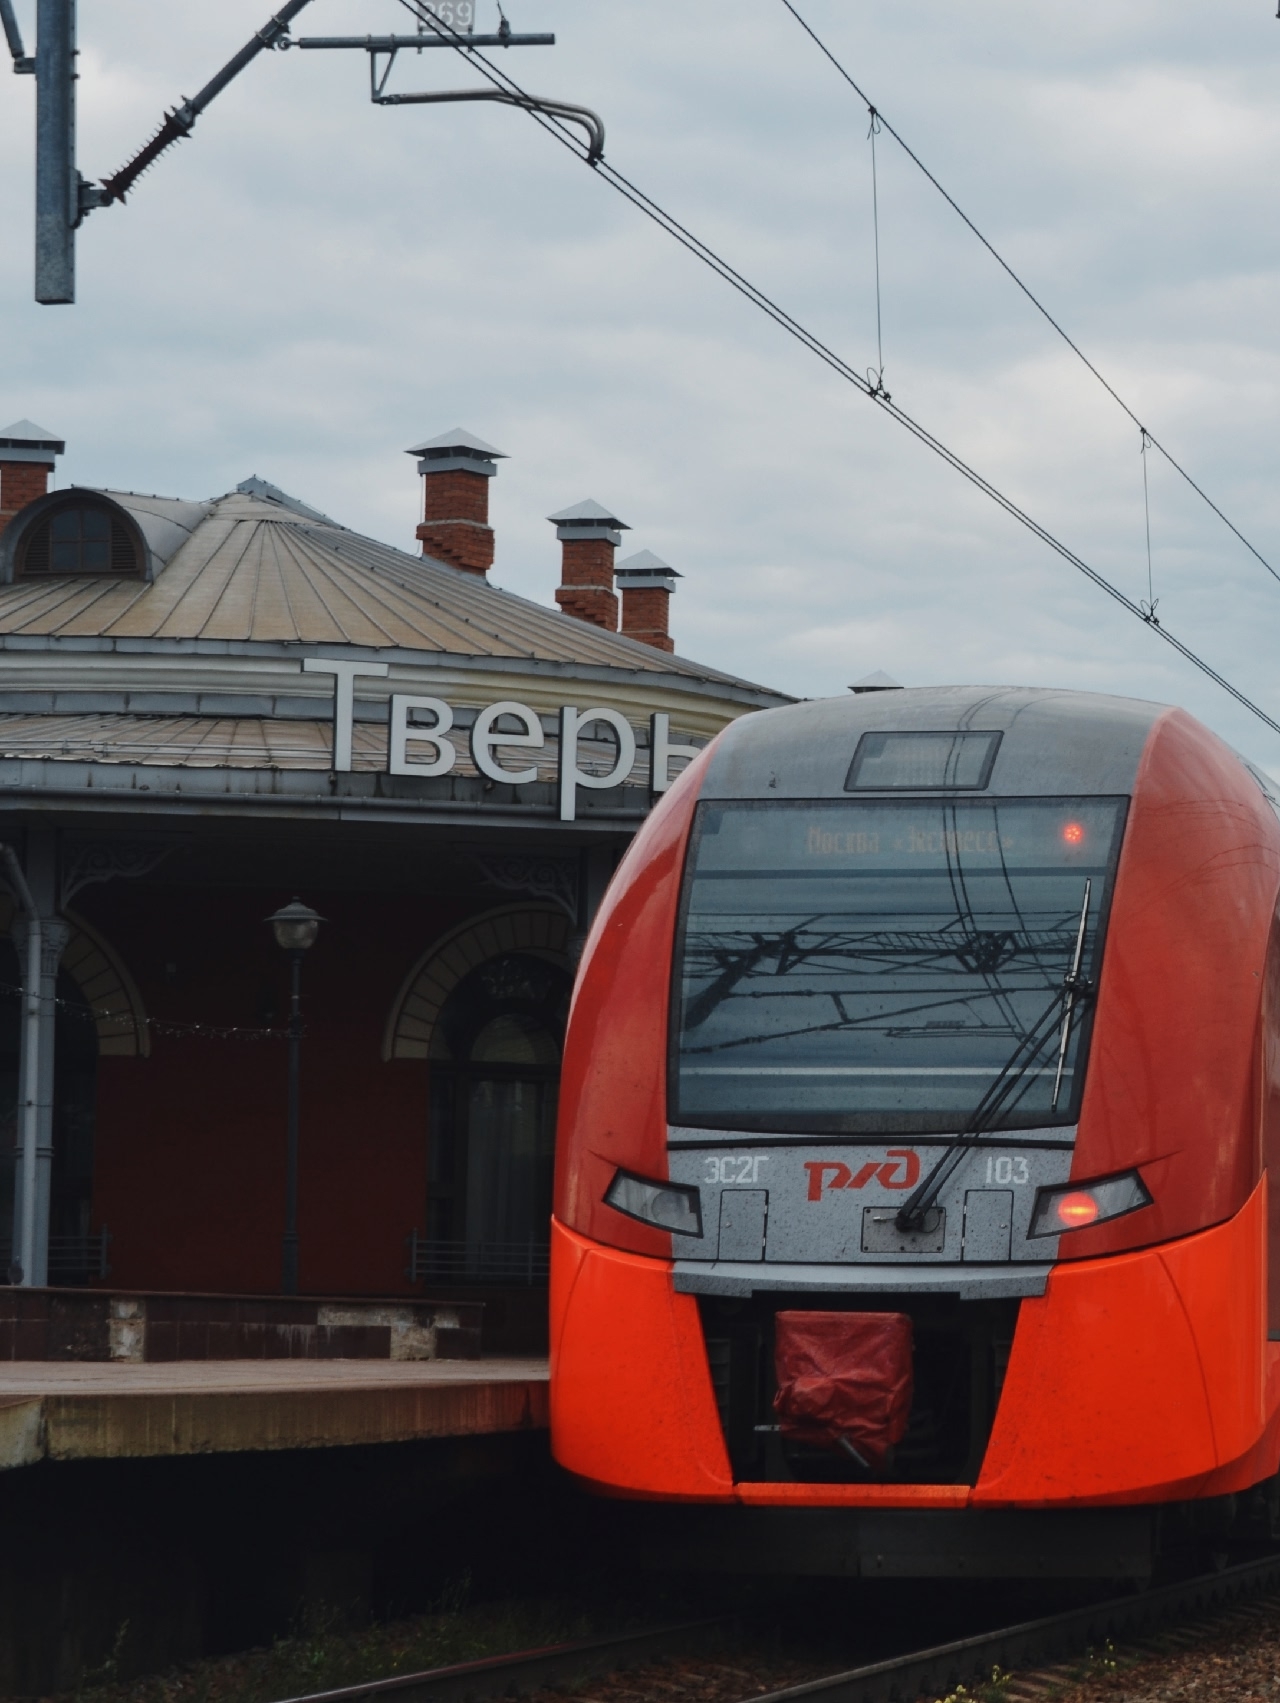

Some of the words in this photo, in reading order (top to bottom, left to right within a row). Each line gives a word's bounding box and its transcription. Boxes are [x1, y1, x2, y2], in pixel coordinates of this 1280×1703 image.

[420, 1, 472, 26] 269
[302, 658, 702, 822] Тверь
[985, 1156, 1029, 1184] 103
